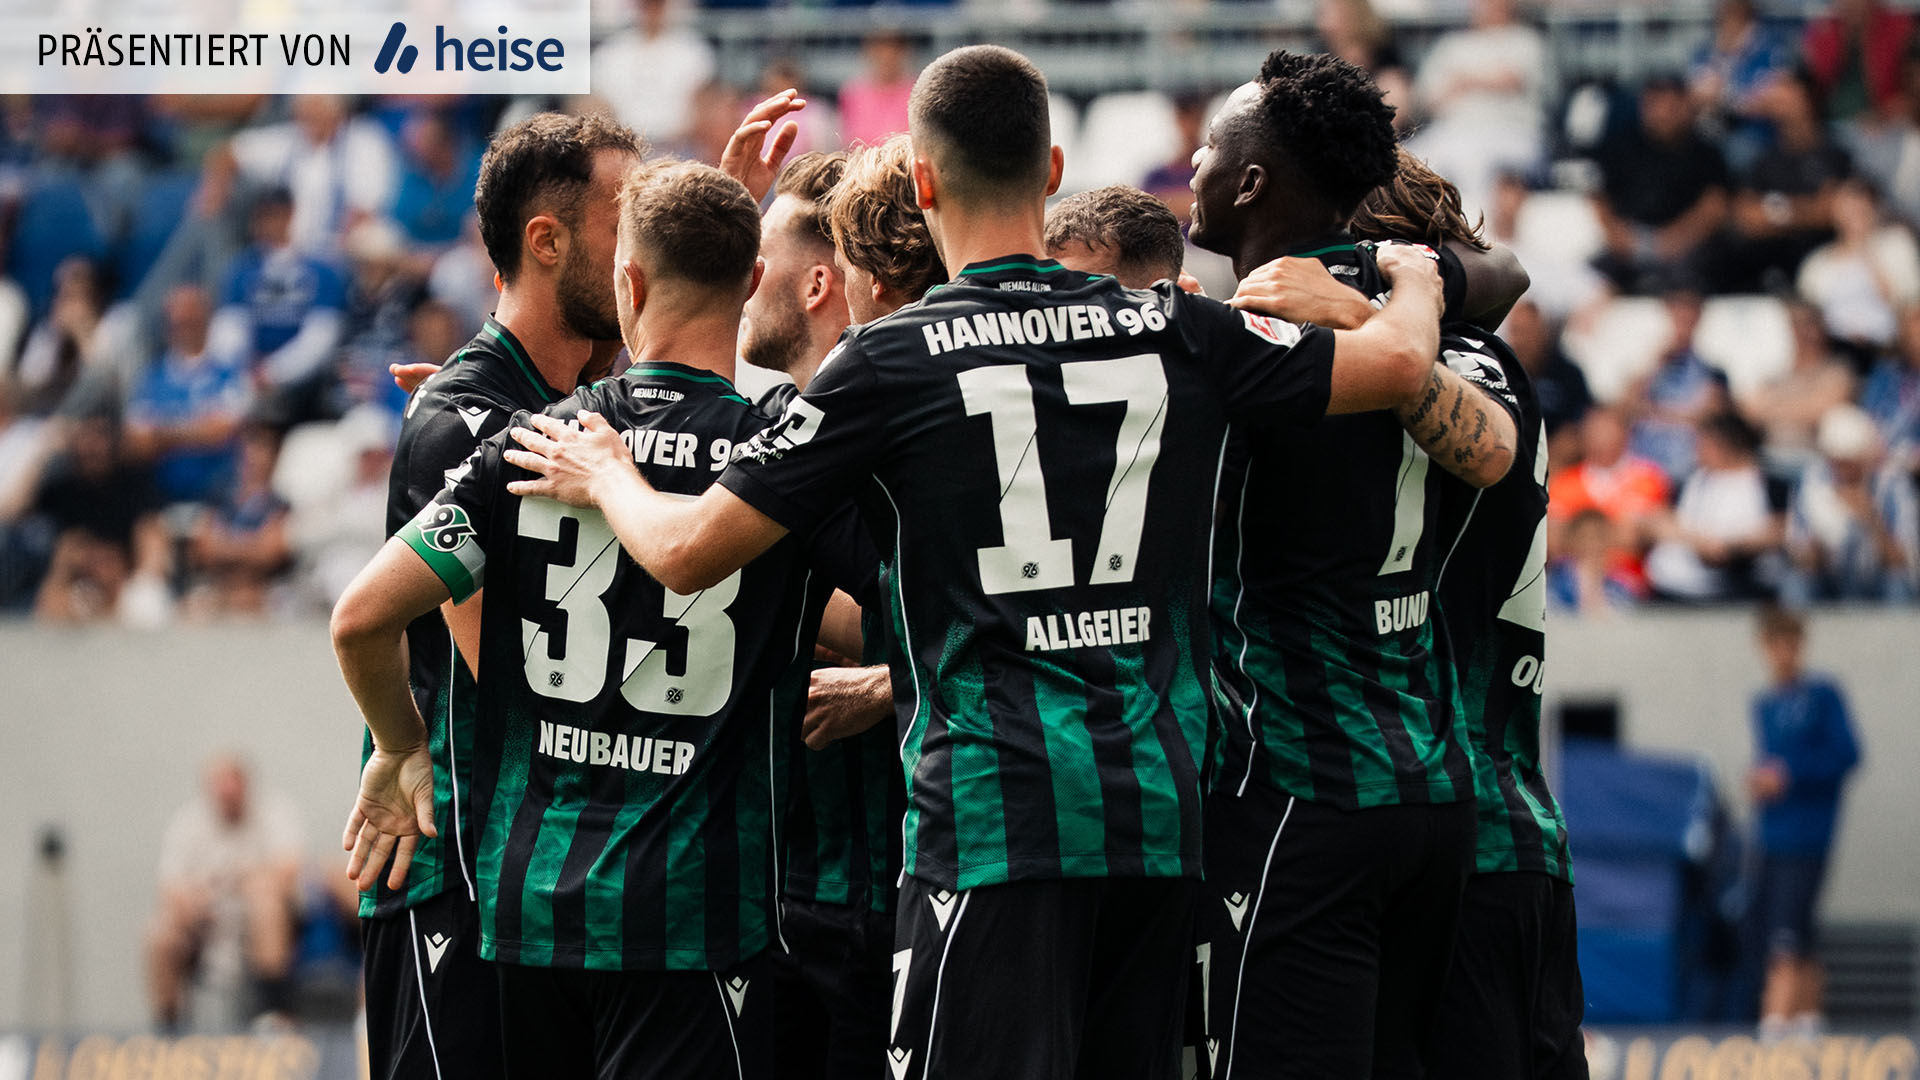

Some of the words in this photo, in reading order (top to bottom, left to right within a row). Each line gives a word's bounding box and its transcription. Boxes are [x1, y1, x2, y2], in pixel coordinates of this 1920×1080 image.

[922, 304, 1116, 356] HANNOVER
[1116, 302, 1168, 337] 96
[710, 438, 733, 472] 9
[956, 353, 1169, 595] 17
[417, 504, 478, 552] 96
[517, 493, 742, 717] 33
[1025, 606, 1151, 651] ALLGEIER
[1374, 590, 1430, 635] BUND
[538, 719, 696, 776] NEUBAUER
